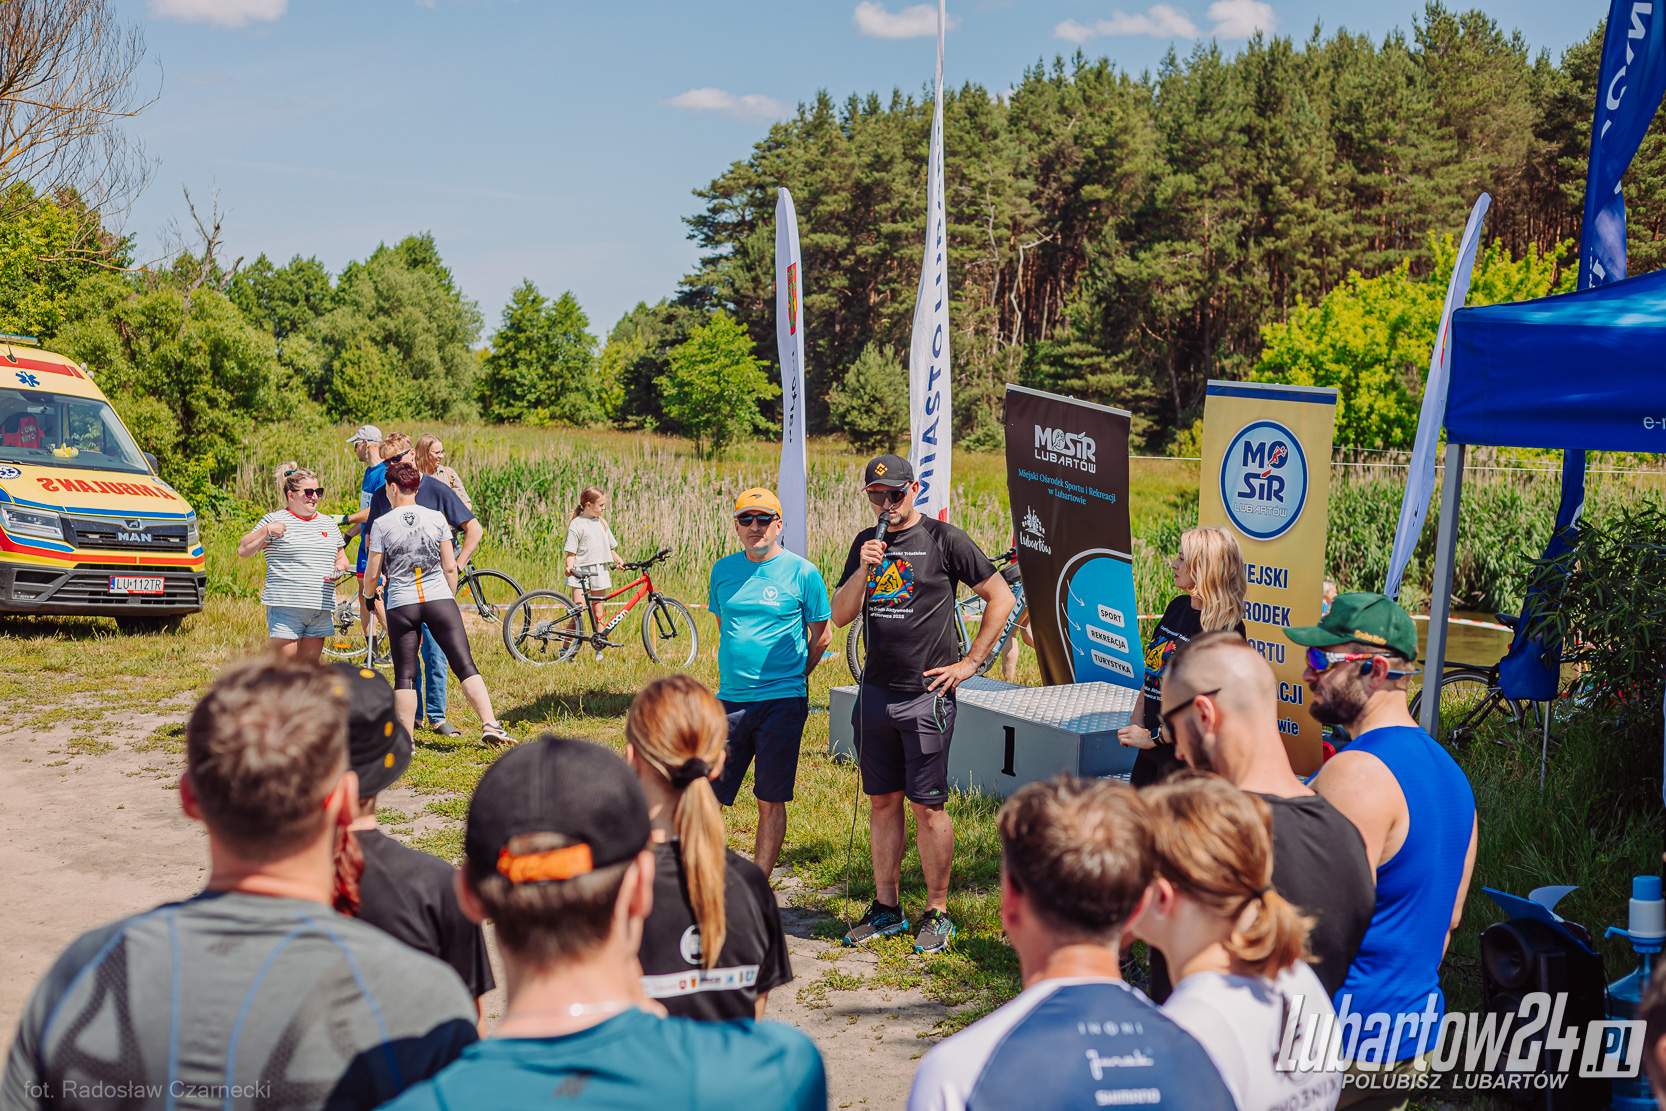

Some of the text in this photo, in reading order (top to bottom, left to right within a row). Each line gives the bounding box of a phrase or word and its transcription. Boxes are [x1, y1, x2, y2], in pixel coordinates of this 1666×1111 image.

[914, 323, 942, 507] MIASTO
[1034, 449, 1096, 474] LUBARTÓW
[1018, 468, 1038, 481] Miejski
[1040, 472, 1064, 487] Ośrodek
[1064, 481, 1085, 494] Sportu
[1088, 487, 1116, 504] Rekreacji
[1055, 488, 1088, 505] Lubartowie
[117, 532, 152, 542] MAN
[134, 579, 162, 590] 112TR
[1100, 609, 1121, 623] SPORT
[1090, 630, 1126, 649] REKREACJA
[1093, 653, 1132, 674] TURYSTYKA
[1001, 725, 1017, 777] 1
